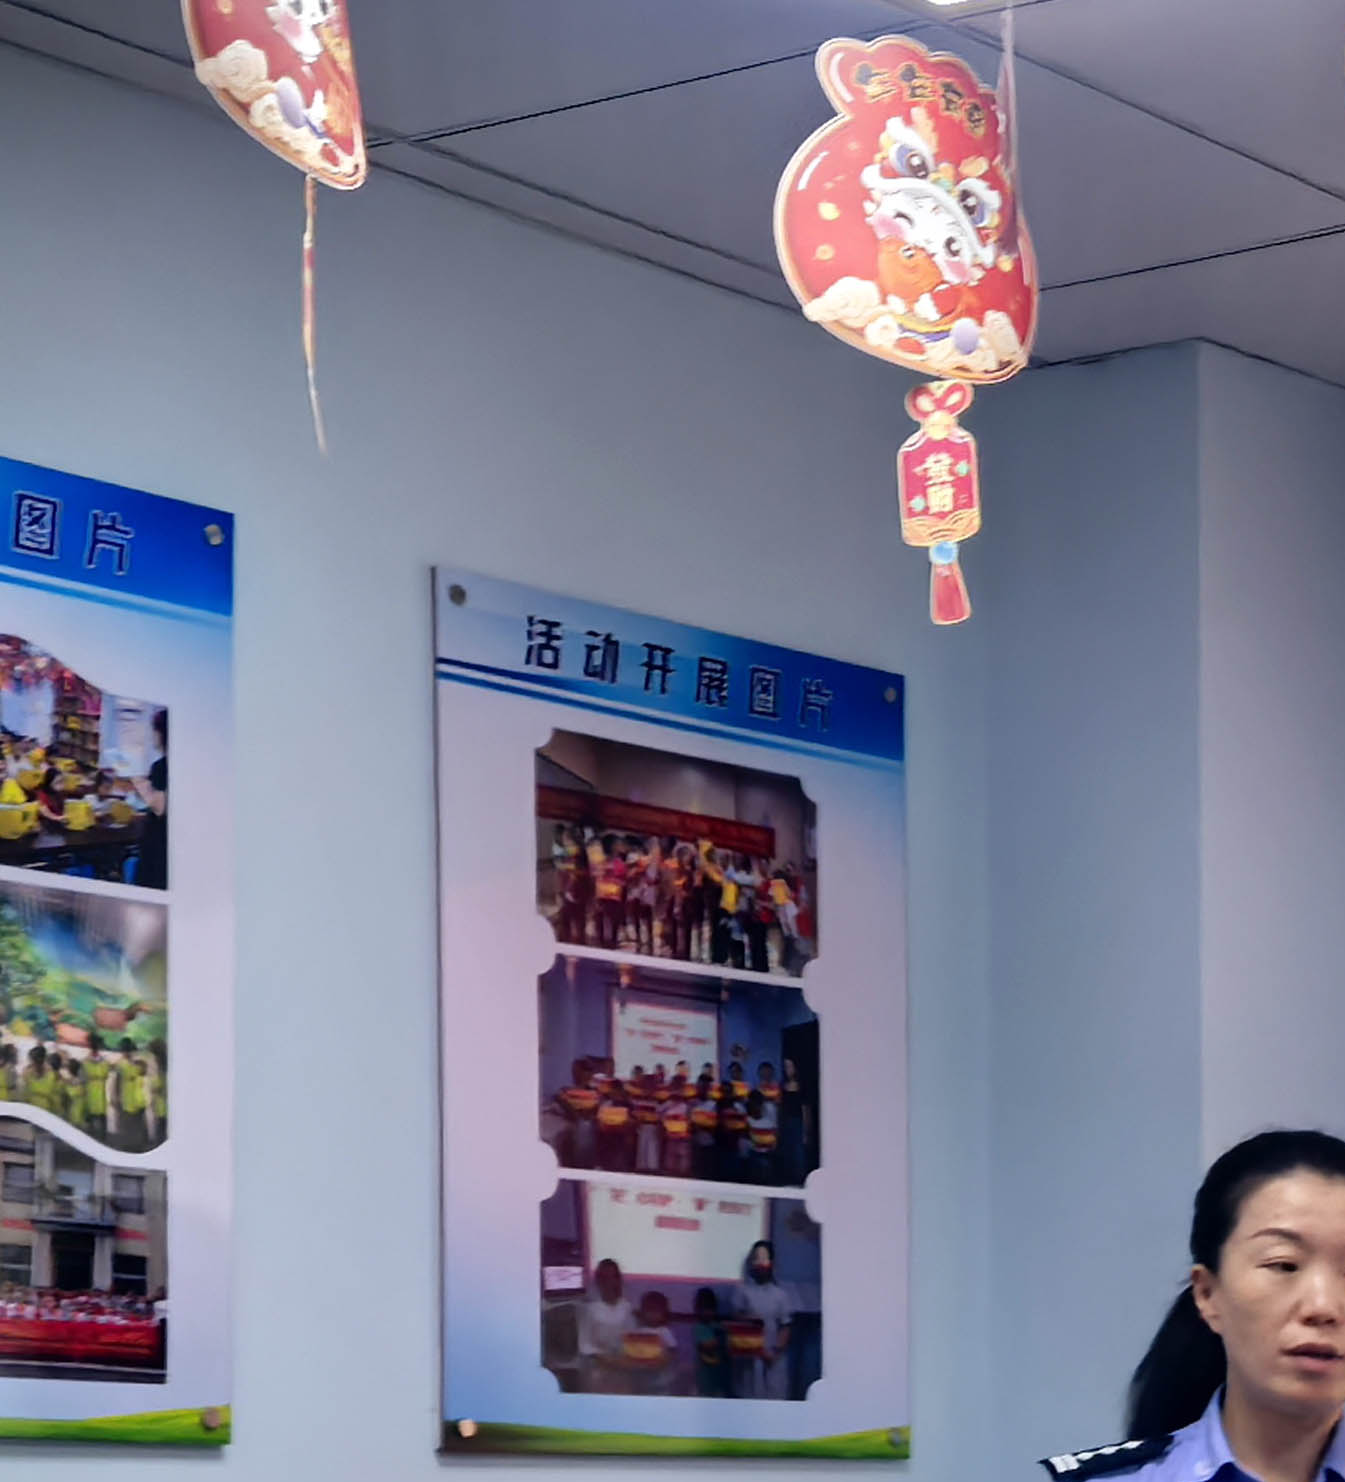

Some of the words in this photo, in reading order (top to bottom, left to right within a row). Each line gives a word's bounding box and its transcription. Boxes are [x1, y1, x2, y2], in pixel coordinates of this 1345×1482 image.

[12, 490, 135, 576] 图片
[524, 614, 834, 733] 活动开展图片
